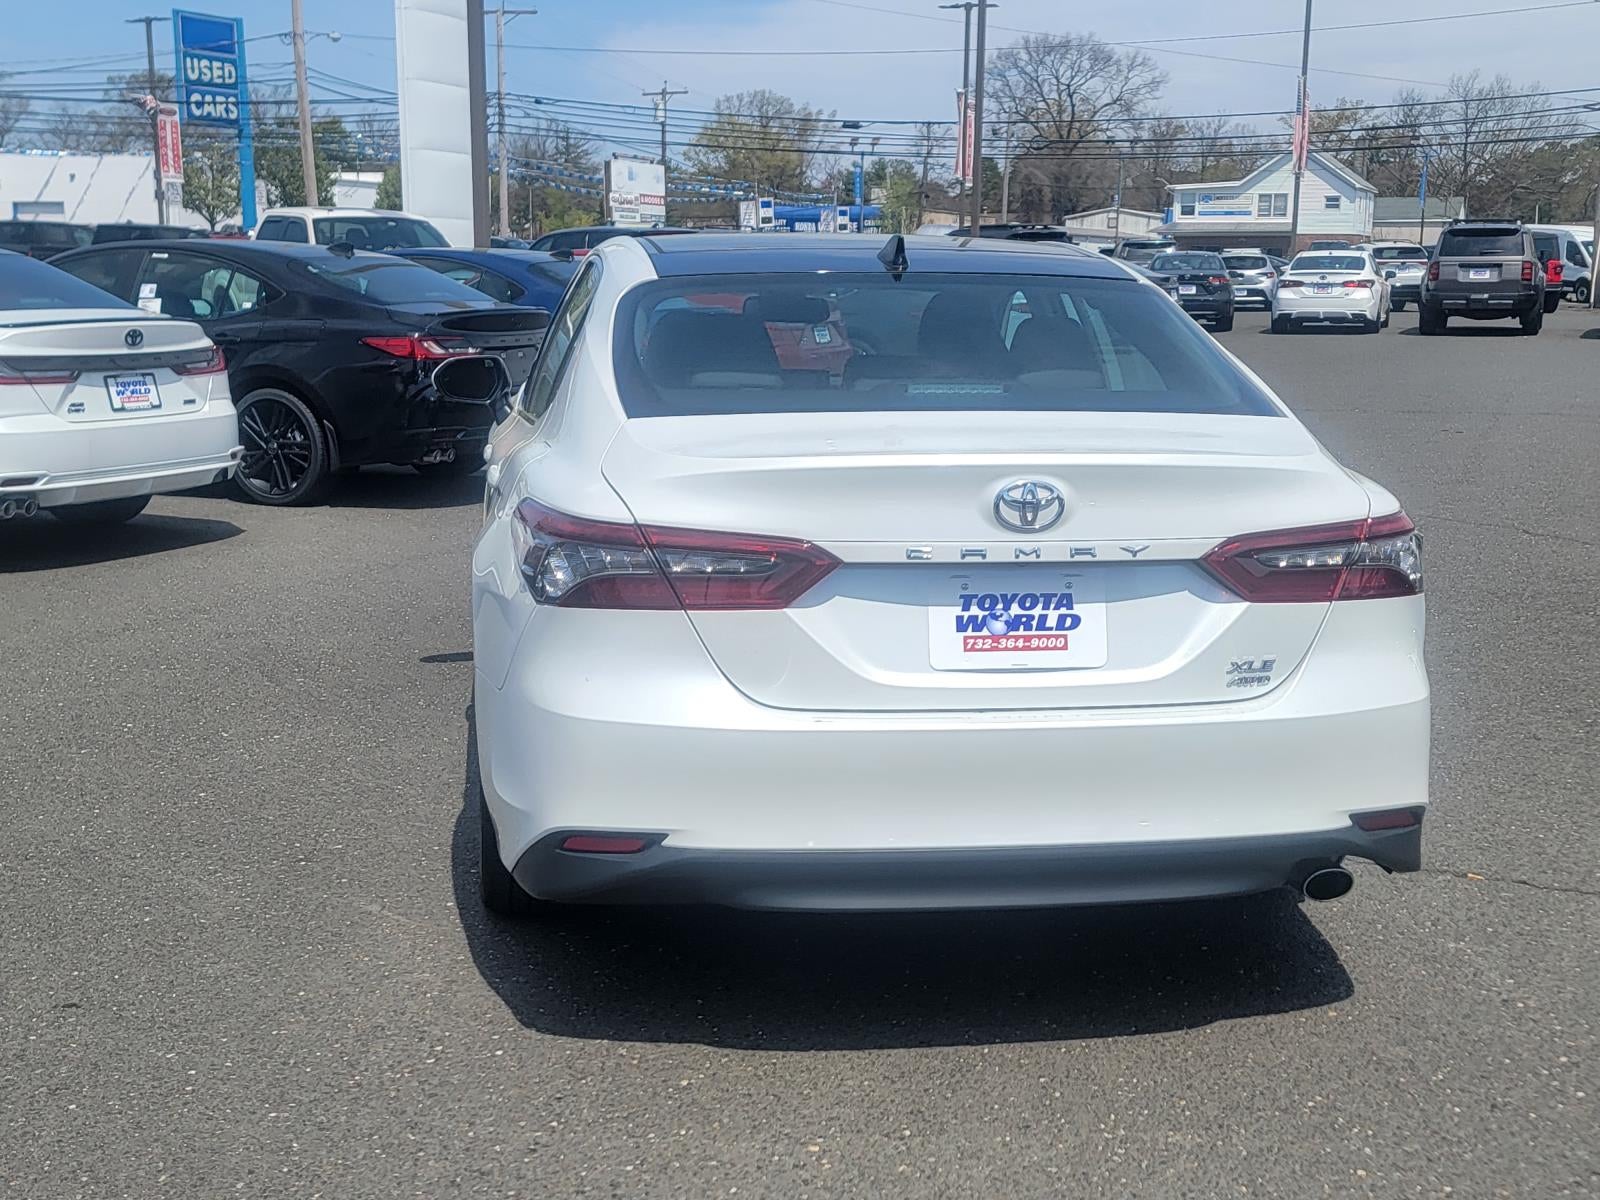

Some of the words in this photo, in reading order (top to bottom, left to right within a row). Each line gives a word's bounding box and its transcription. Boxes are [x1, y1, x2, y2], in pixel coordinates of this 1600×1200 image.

[186, 57, 236, 84] USED
[190, 93, 238, 119] CARS
[115, 380, 147, 388] TOYOTA
[116, 387, 151, 396] WORLD
[906, 545, 1150, 560] CAMRY
[959, 593, 1075, 611] TOYOTA
[956, 610, 1081, 634] WORLD
[966, 636, 1065, 650] 732-364-9000
[1226, 659, 1276, 674] XLE
